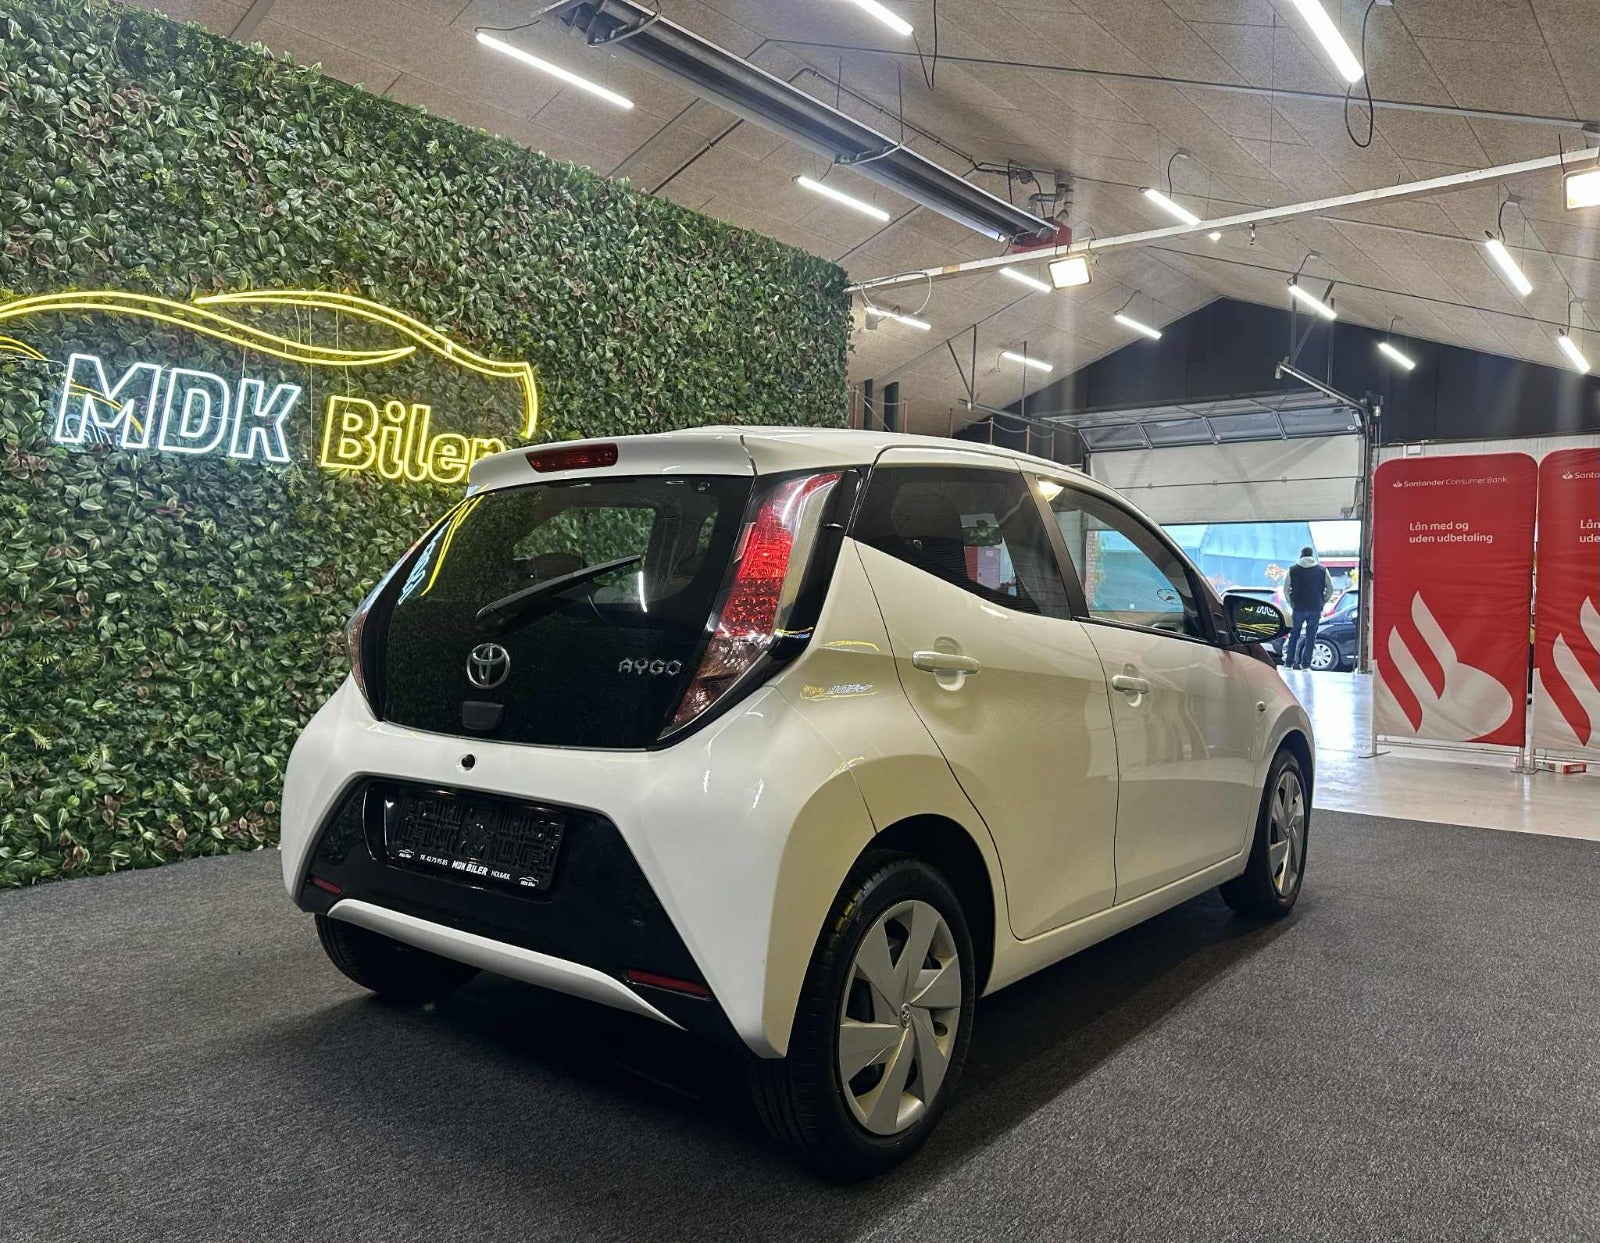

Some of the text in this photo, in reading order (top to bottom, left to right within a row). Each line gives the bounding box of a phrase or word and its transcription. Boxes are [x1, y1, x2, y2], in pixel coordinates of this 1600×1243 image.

[54, 352, 302, 463] MDK
[1403, 476, 1508, 488] Santander Consumer Bank
[1409, 521, 1469, 531] Lån med og
[1409, 532, 1494, 544] uden udbetaling
[618, 657, 683, 677] AYGO
[466, 863, 488, 876] BILER
